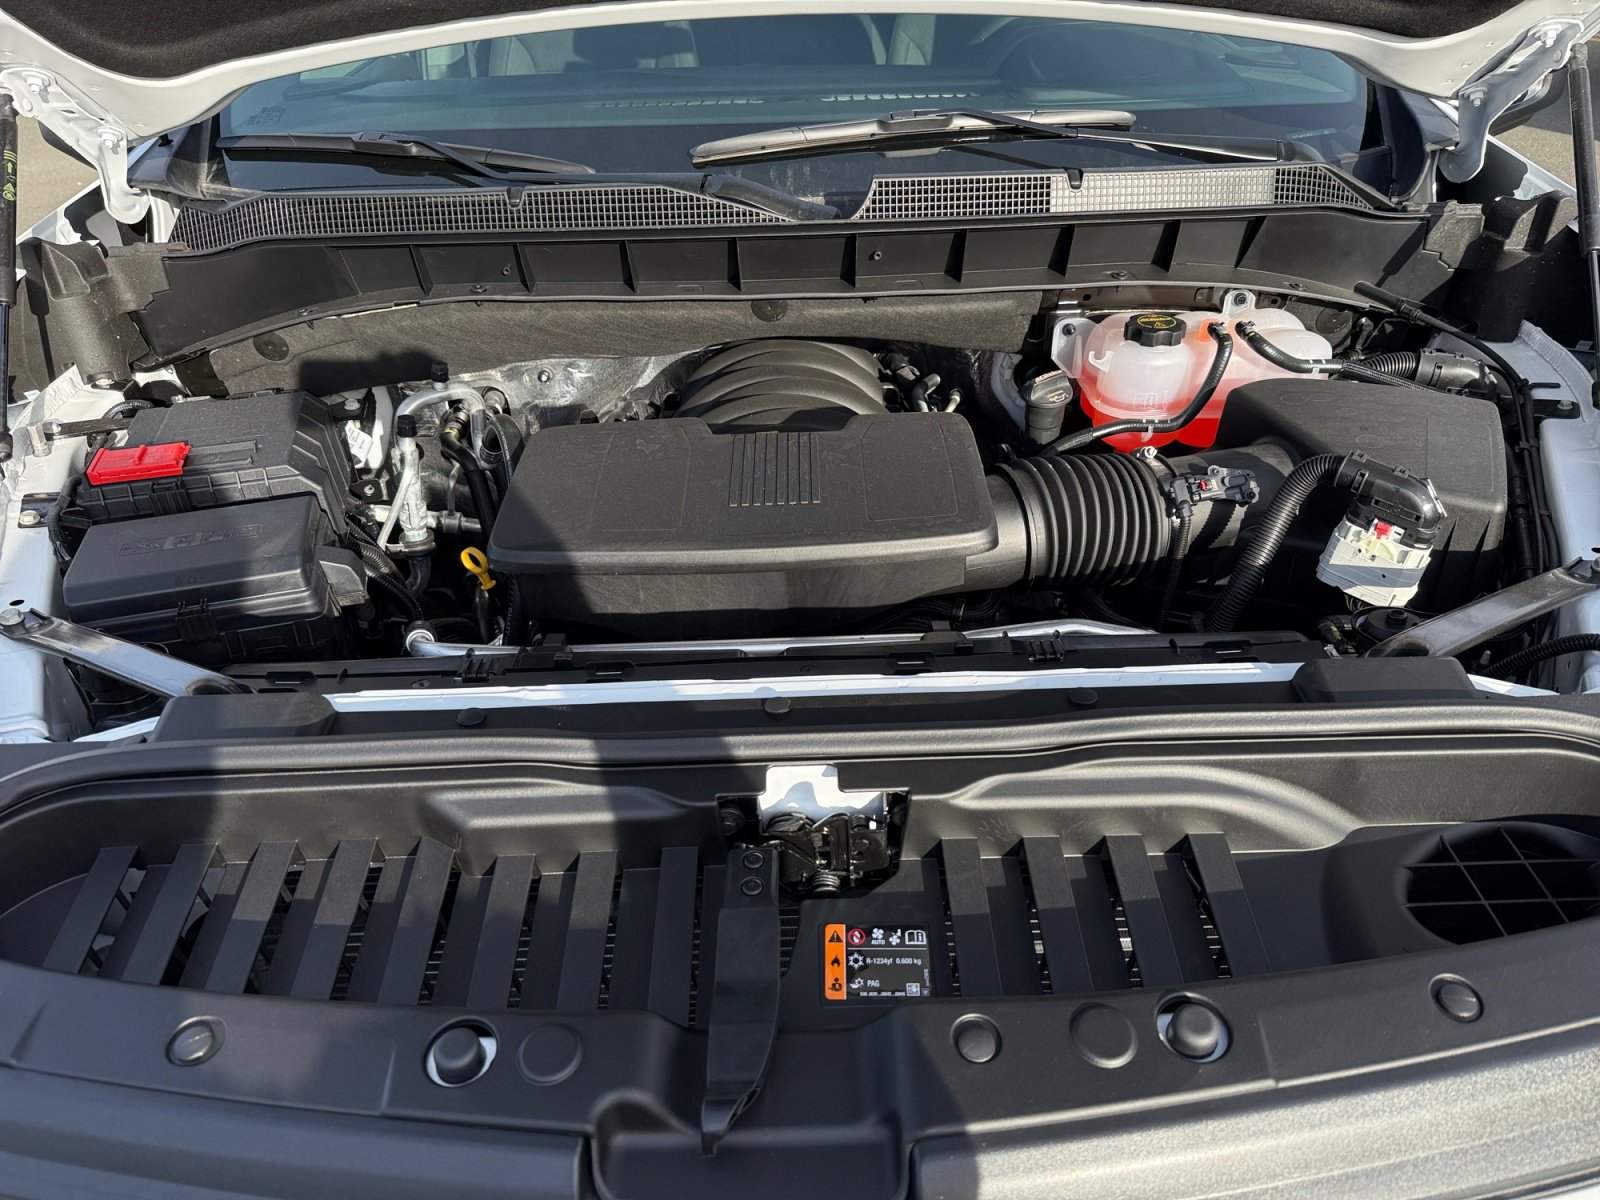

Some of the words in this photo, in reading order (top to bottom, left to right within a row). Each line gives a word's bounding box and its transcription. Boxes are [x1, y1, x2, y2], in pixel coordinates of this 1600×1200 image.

[866, 957, 893, 966] R-1234yf
[895, 957, 913, 965] 0.600
[913, 957, 922, 966] kg
[867, 979, 880, 988] PAG
